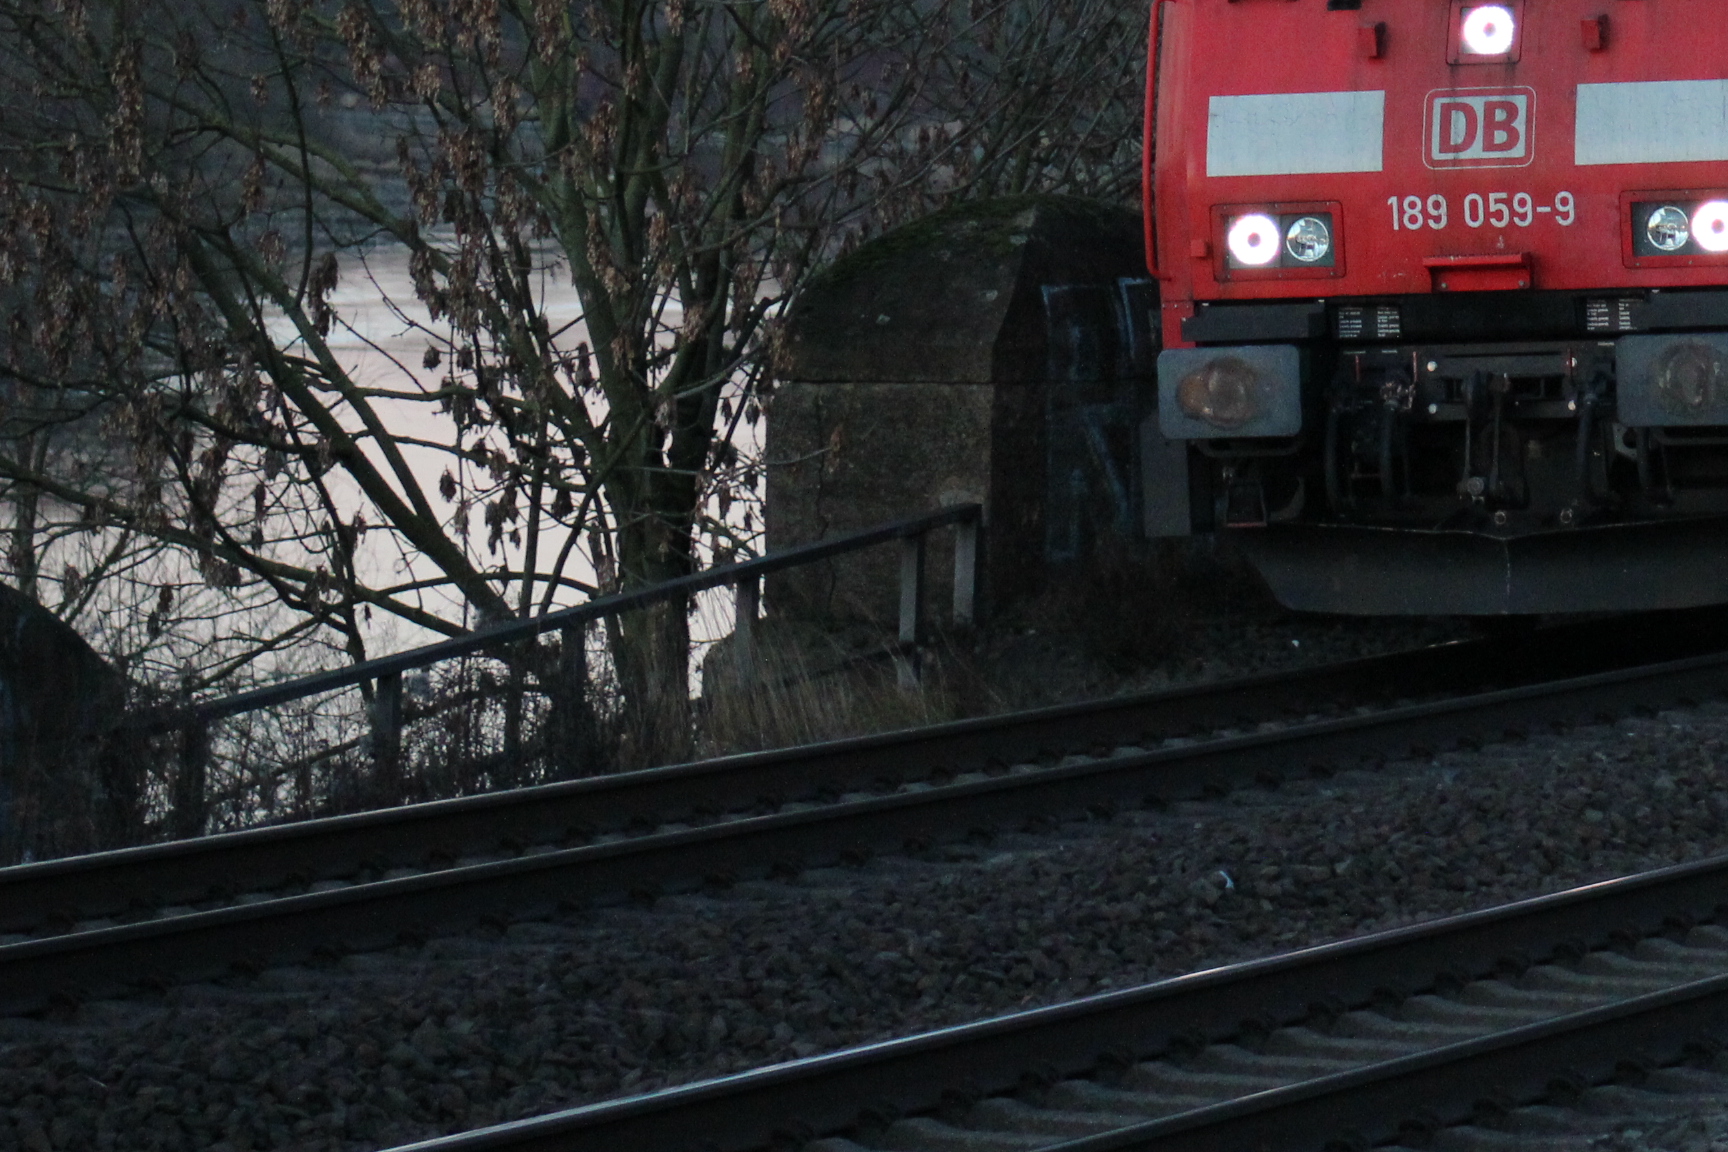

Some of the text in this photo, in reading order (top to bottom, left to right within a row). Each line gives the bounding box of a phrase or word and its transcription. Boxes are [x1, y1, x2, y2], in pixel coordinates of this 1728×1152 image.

[1438, 101, 1521, 153] DB
[1387, 191, 1575, 231] 189 059-9
